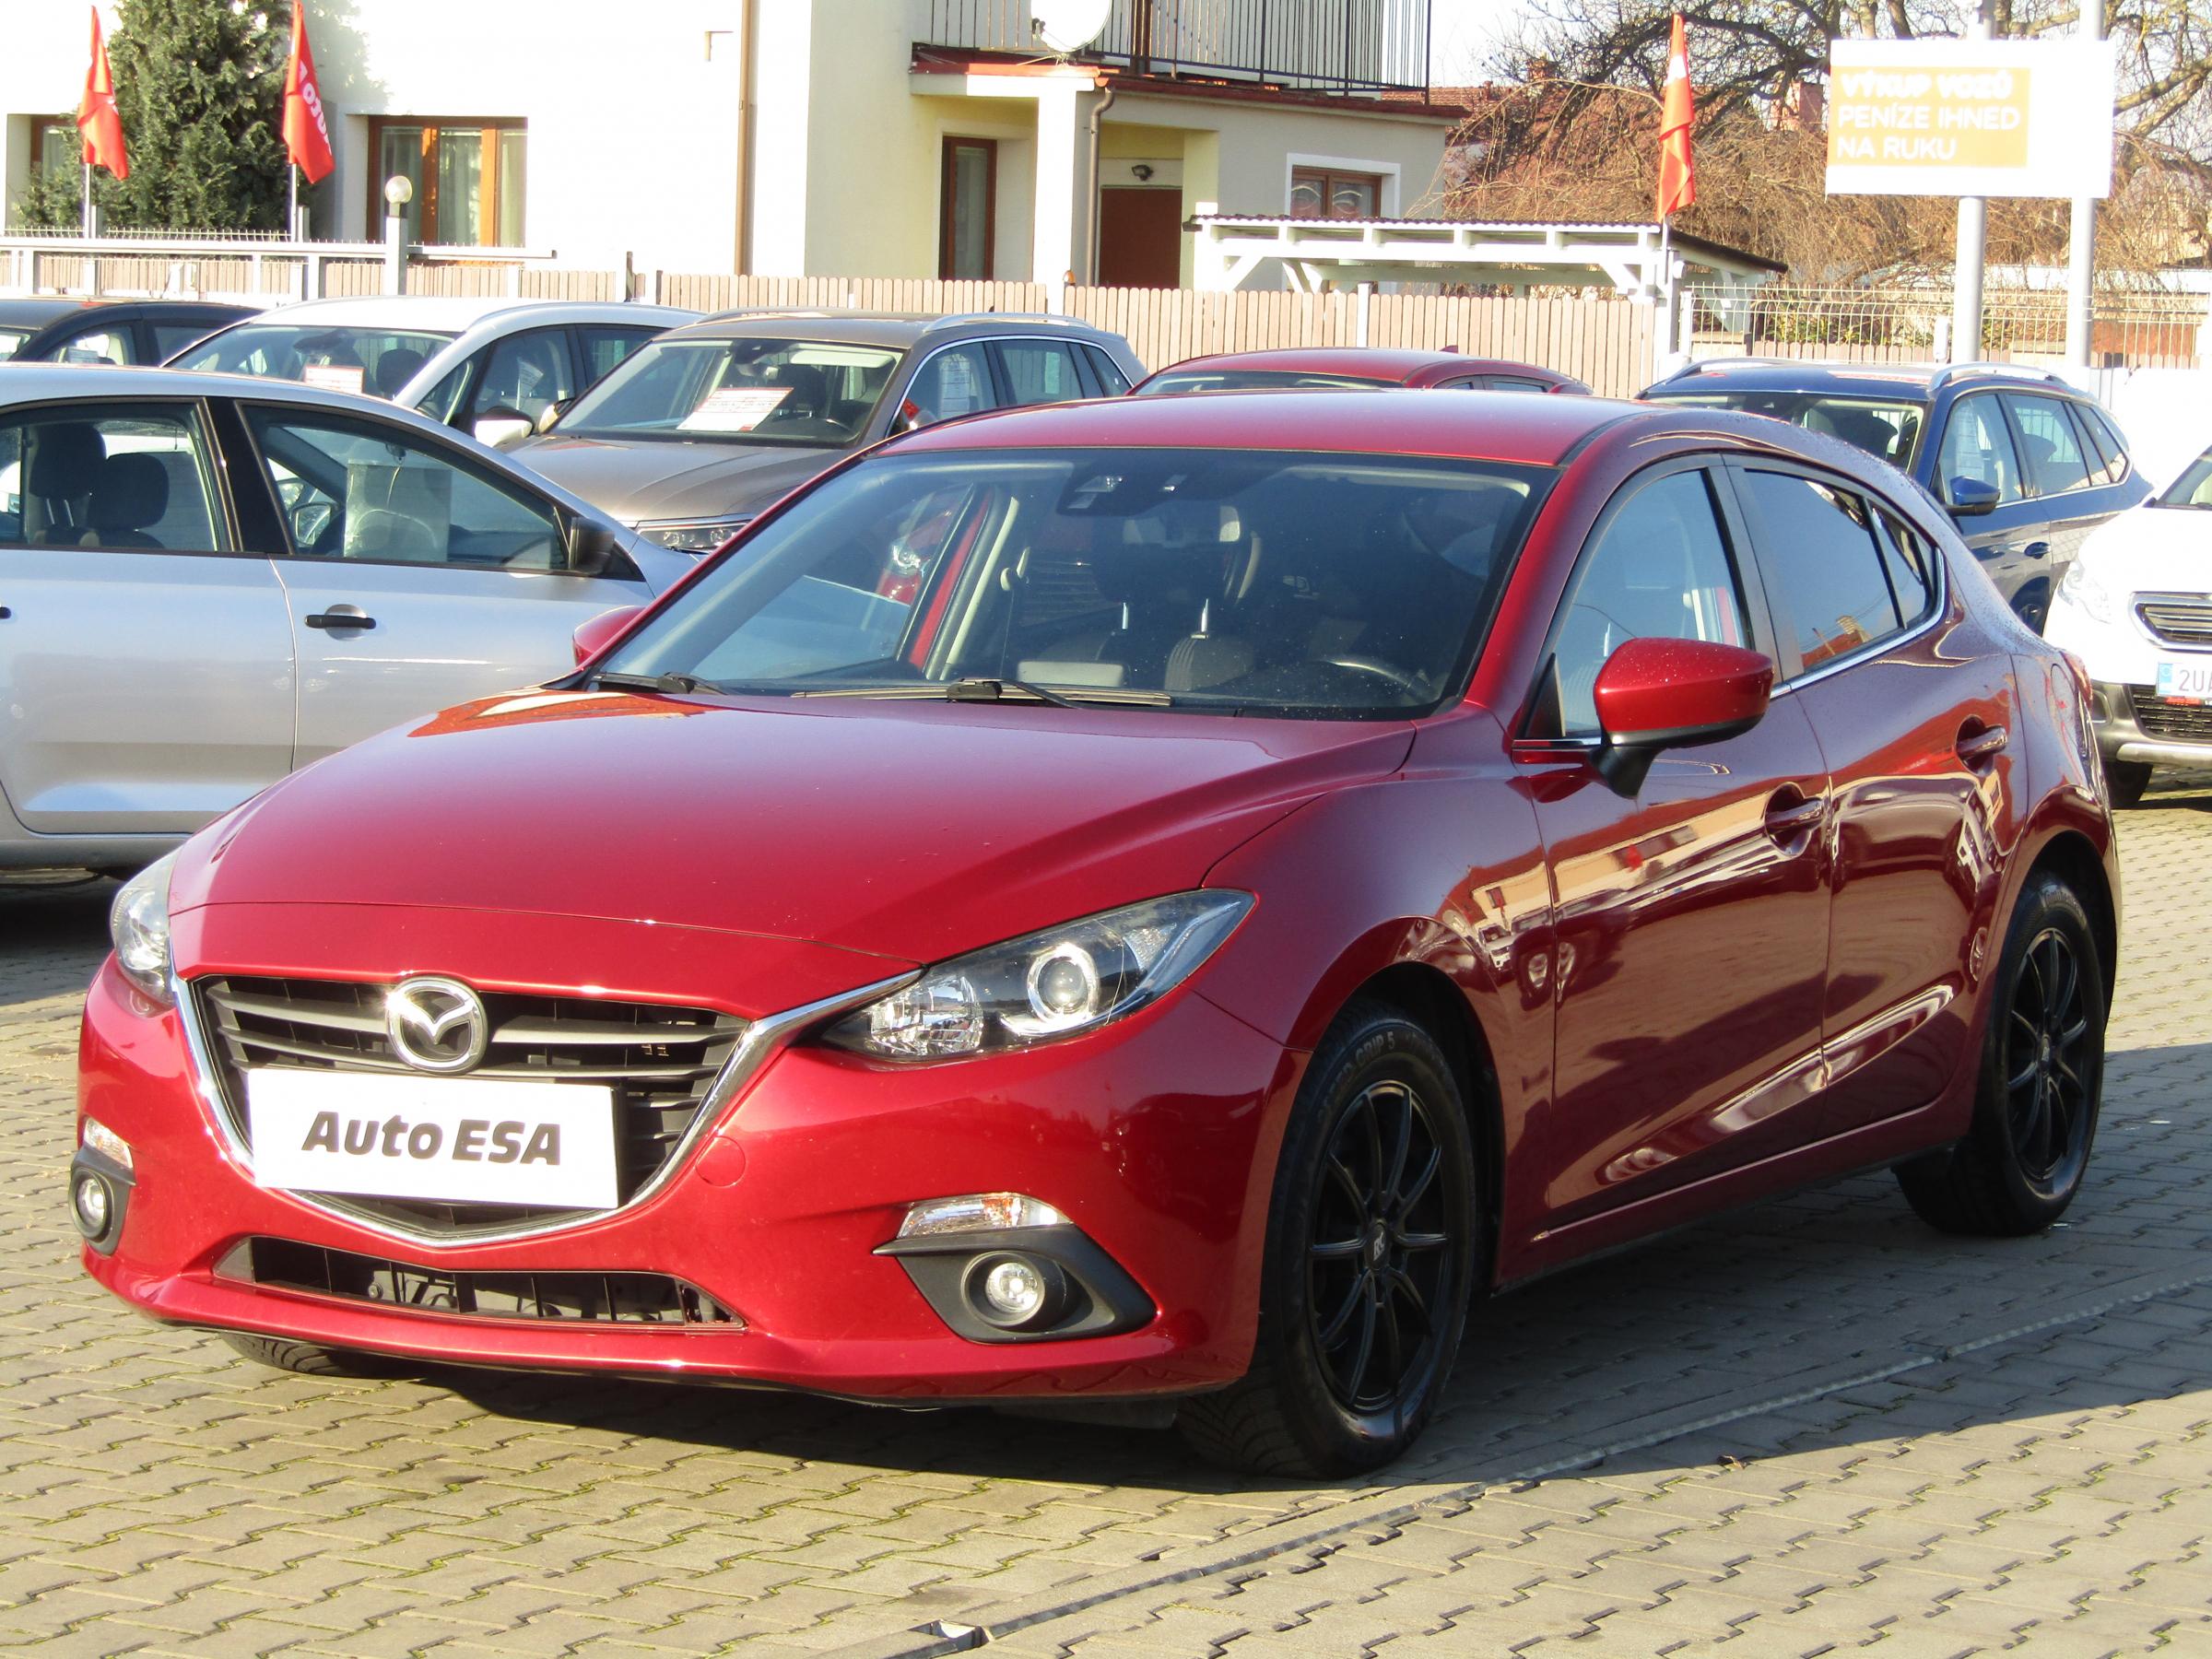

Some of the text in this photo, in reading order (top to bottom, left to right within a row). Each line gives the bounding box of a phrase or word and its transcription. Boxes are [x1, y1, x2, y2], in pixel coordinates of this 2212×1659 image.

[1838, 103, 2020, 130] PENÍZE IHNED
[1837, 136, 1957, 160] NA RUKU
[300, 1111, 561, 1167] Auto ESA
